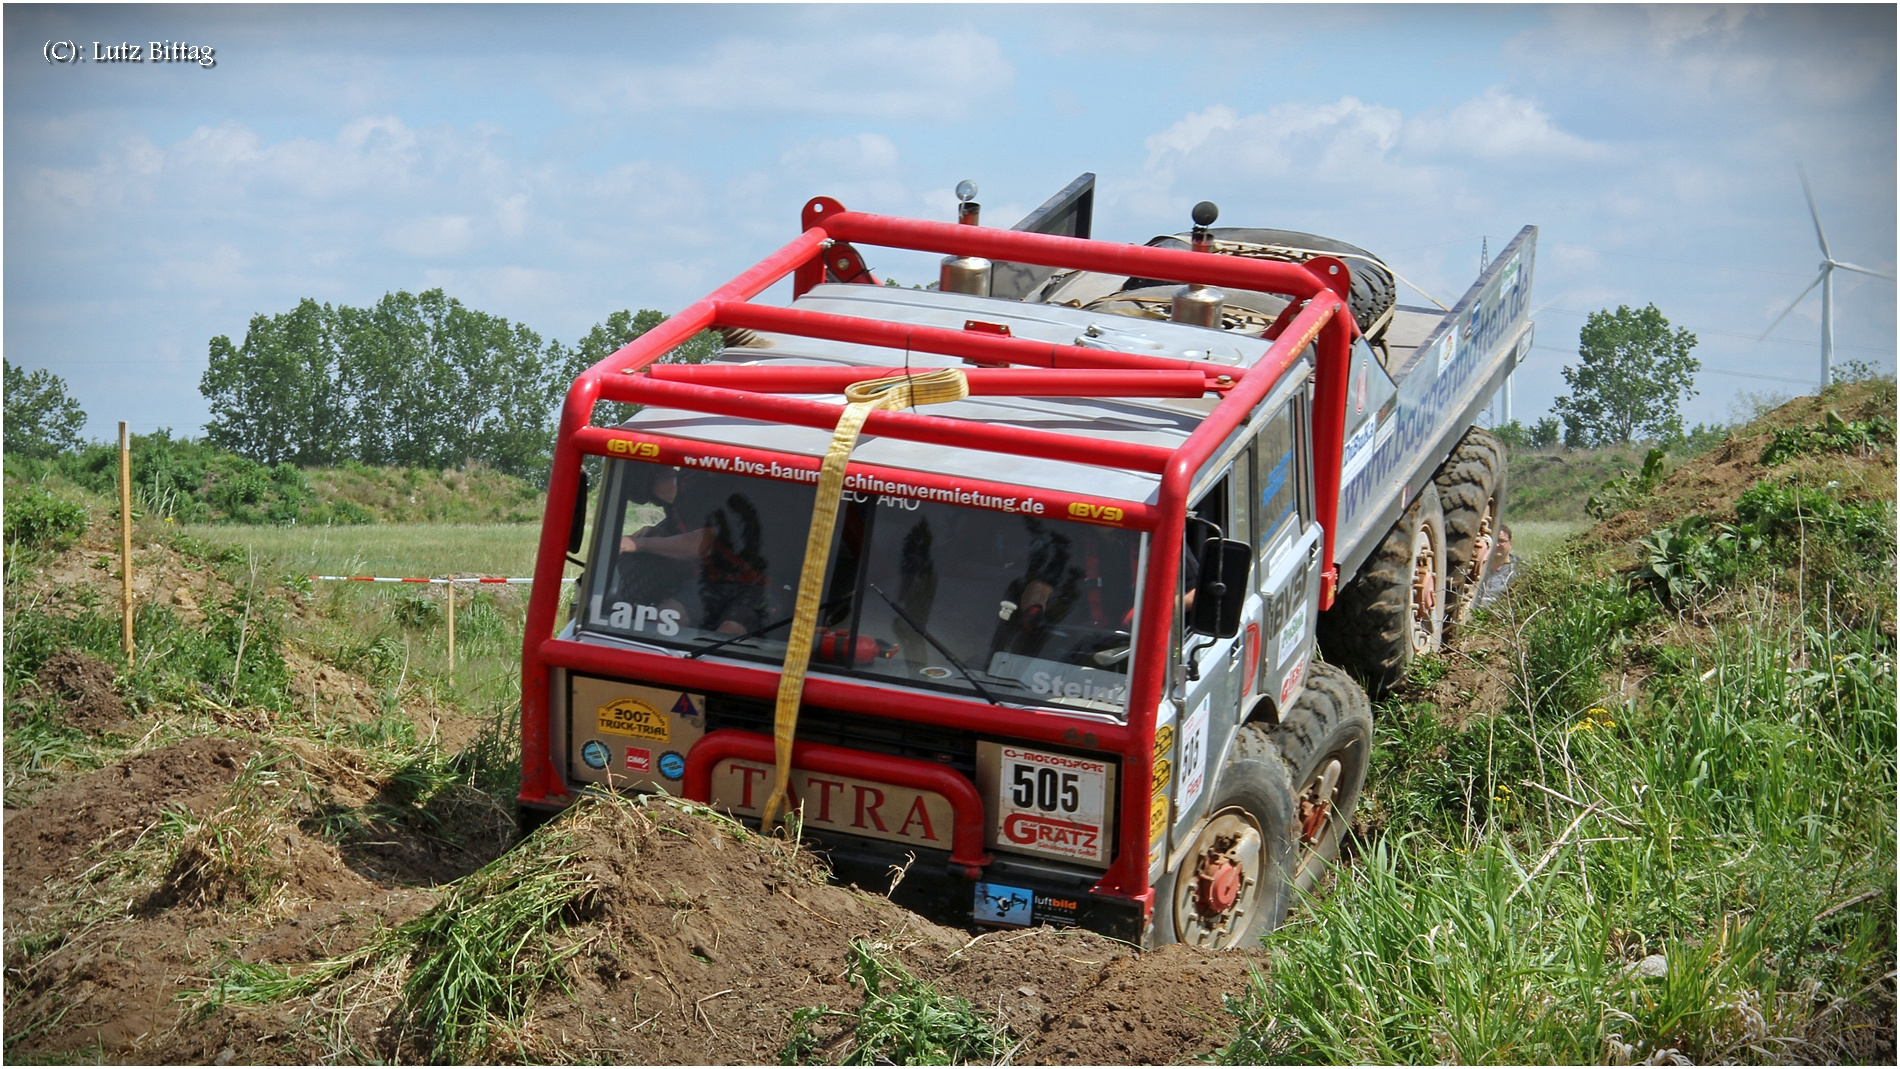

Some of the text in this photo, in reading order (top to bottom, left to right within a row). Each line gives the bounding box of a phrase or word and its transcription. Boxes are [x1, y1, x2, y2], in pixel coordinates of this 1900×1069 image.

[684, 455, 1045, 515] www.bvs-baumchinenvermietung.de
[589, 594, 681, 637] Lars
[599, 718, 668, 737] TRUCK-TRIAL
[614, 707, 651, 724] 2007
[1003, 749, 1104, 773] CS-MOTORSPORT
[1013, 763, 1079, 813] 505
[1034, 895, 1078, 911] luftbild
